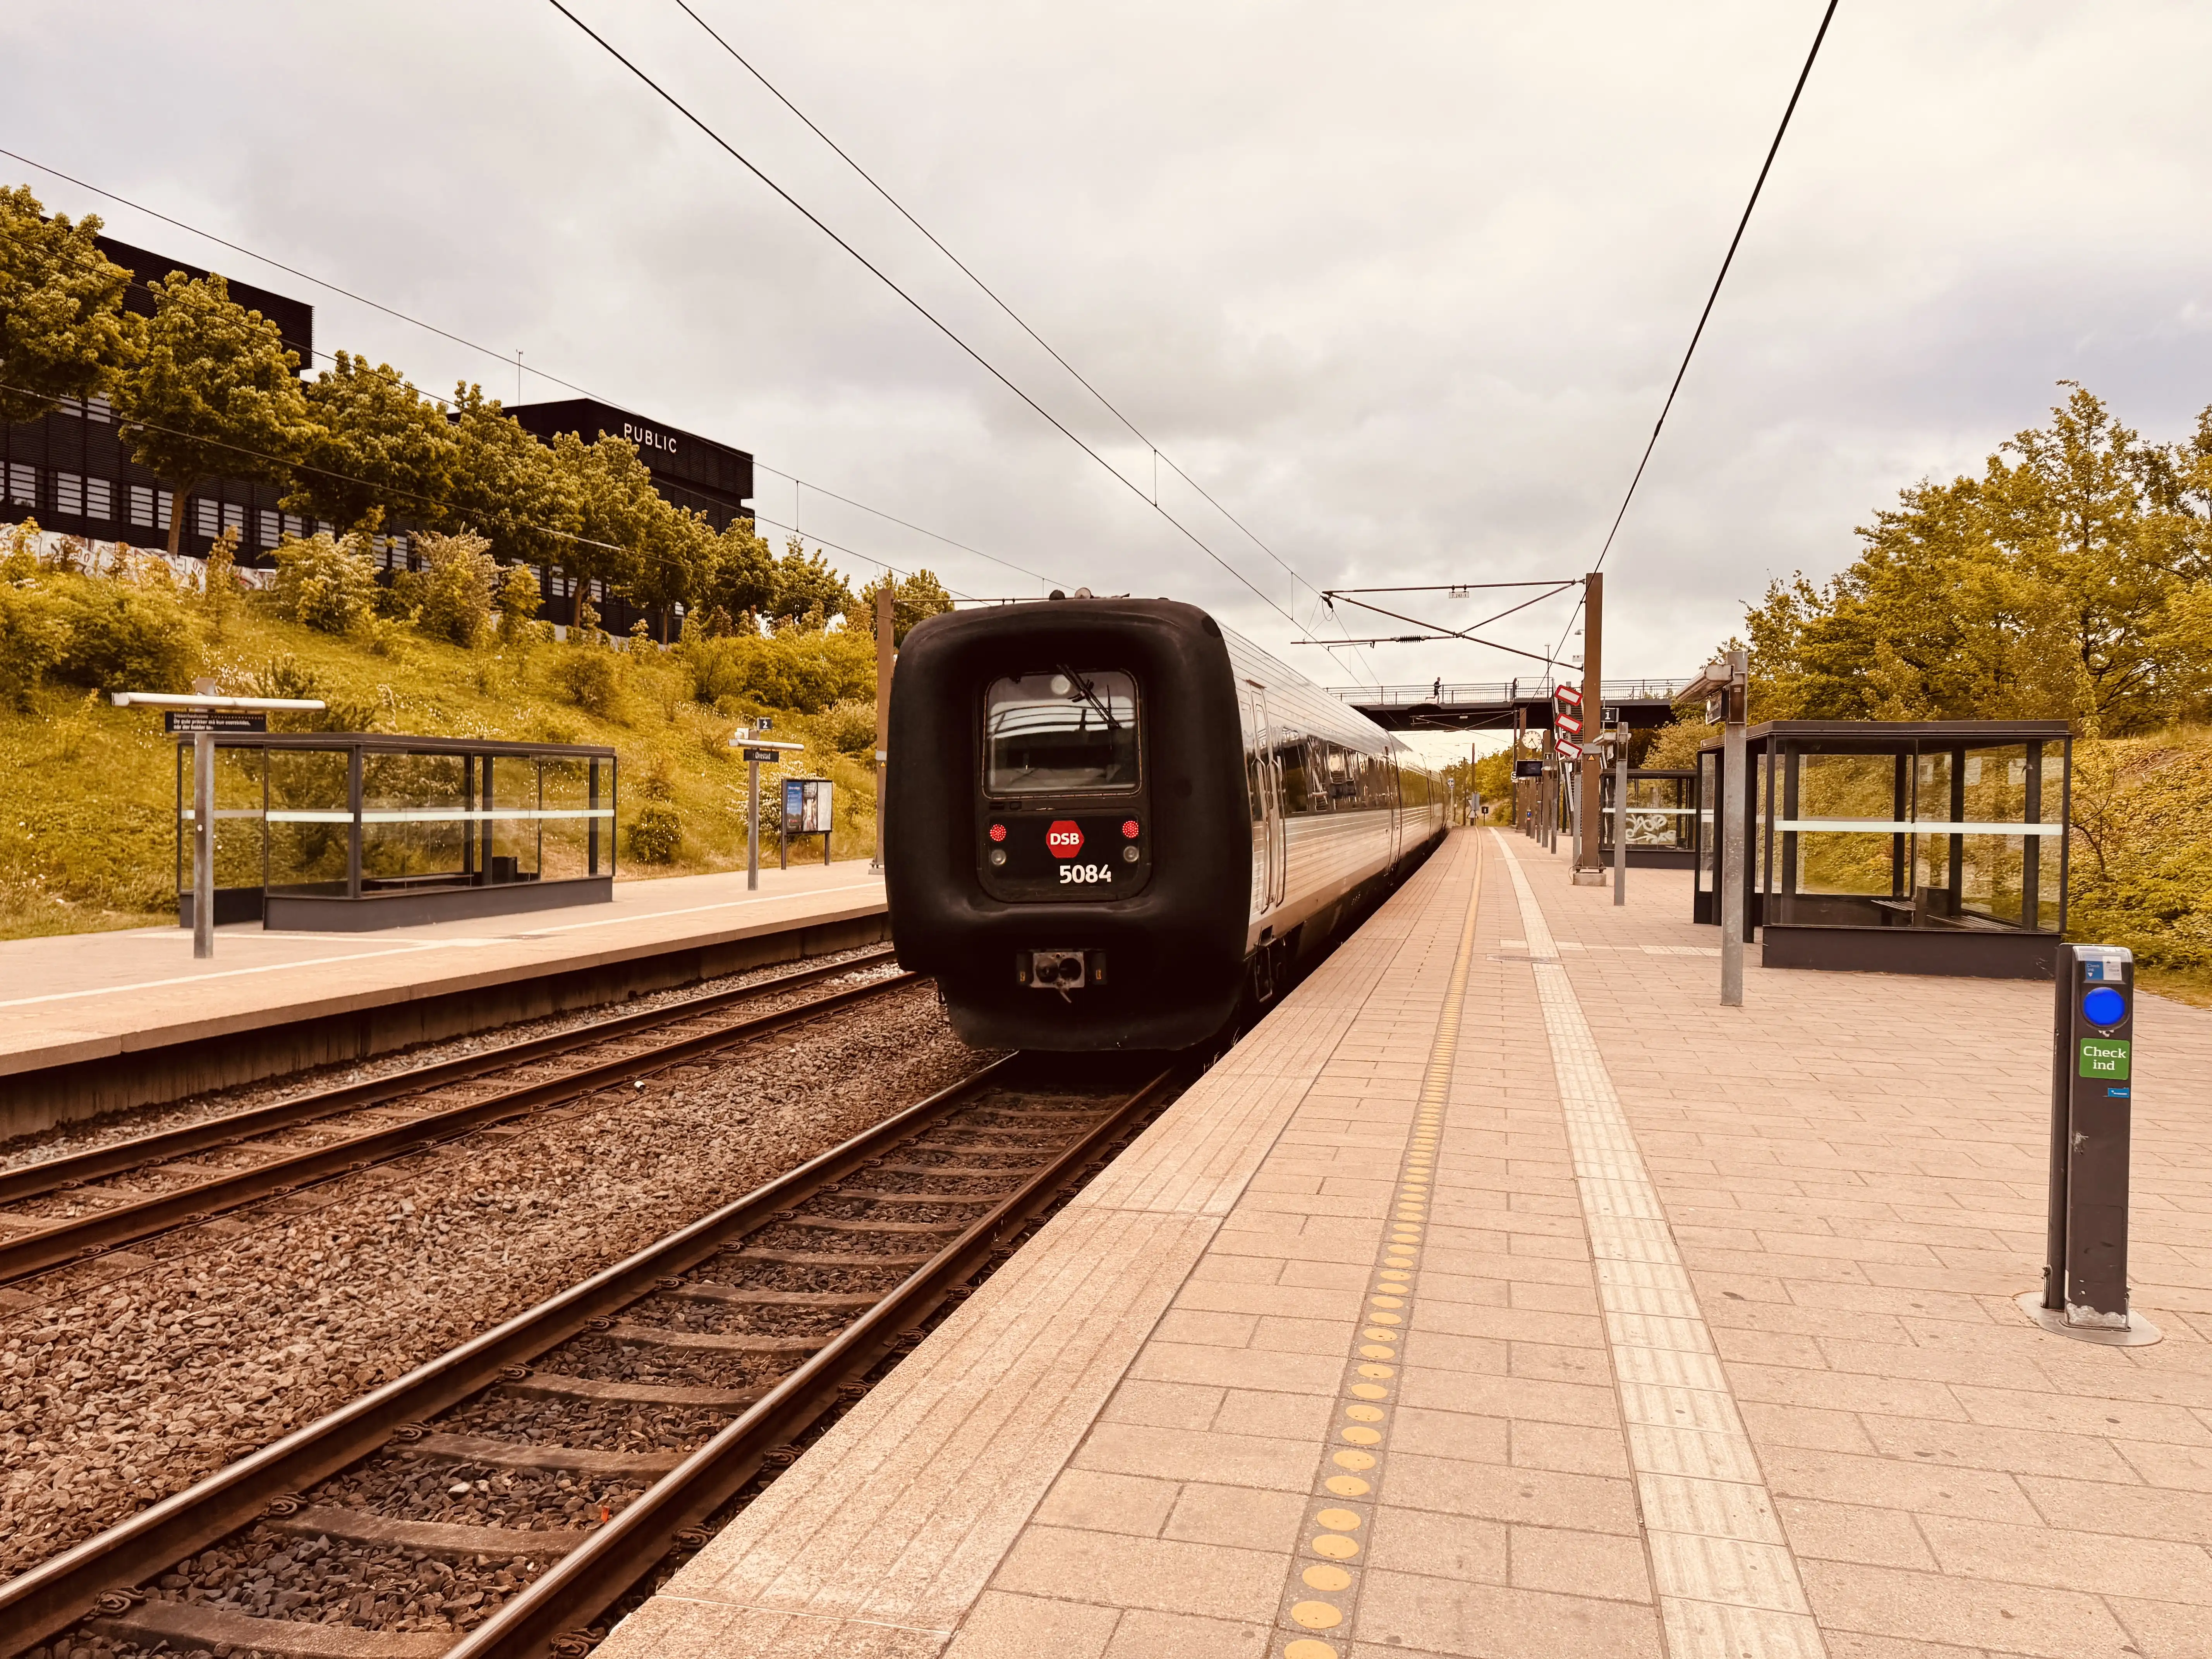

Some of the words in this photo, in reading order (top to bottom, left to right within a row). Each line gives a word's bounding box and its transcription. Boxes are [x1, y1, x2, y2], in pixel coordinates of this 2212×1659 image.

[624, 423, 677, 453] PUBLIC
[1605, 711, 1611, 720] 1
[755, 752, 771, 760] Ørestad
[1050, 833, 1080, 845] DSB
[1060, 864, 1111, 884] 5084
[2083, 1046, 2126, 1058] Check
[2093, 1059, 2115, 1070] ind
